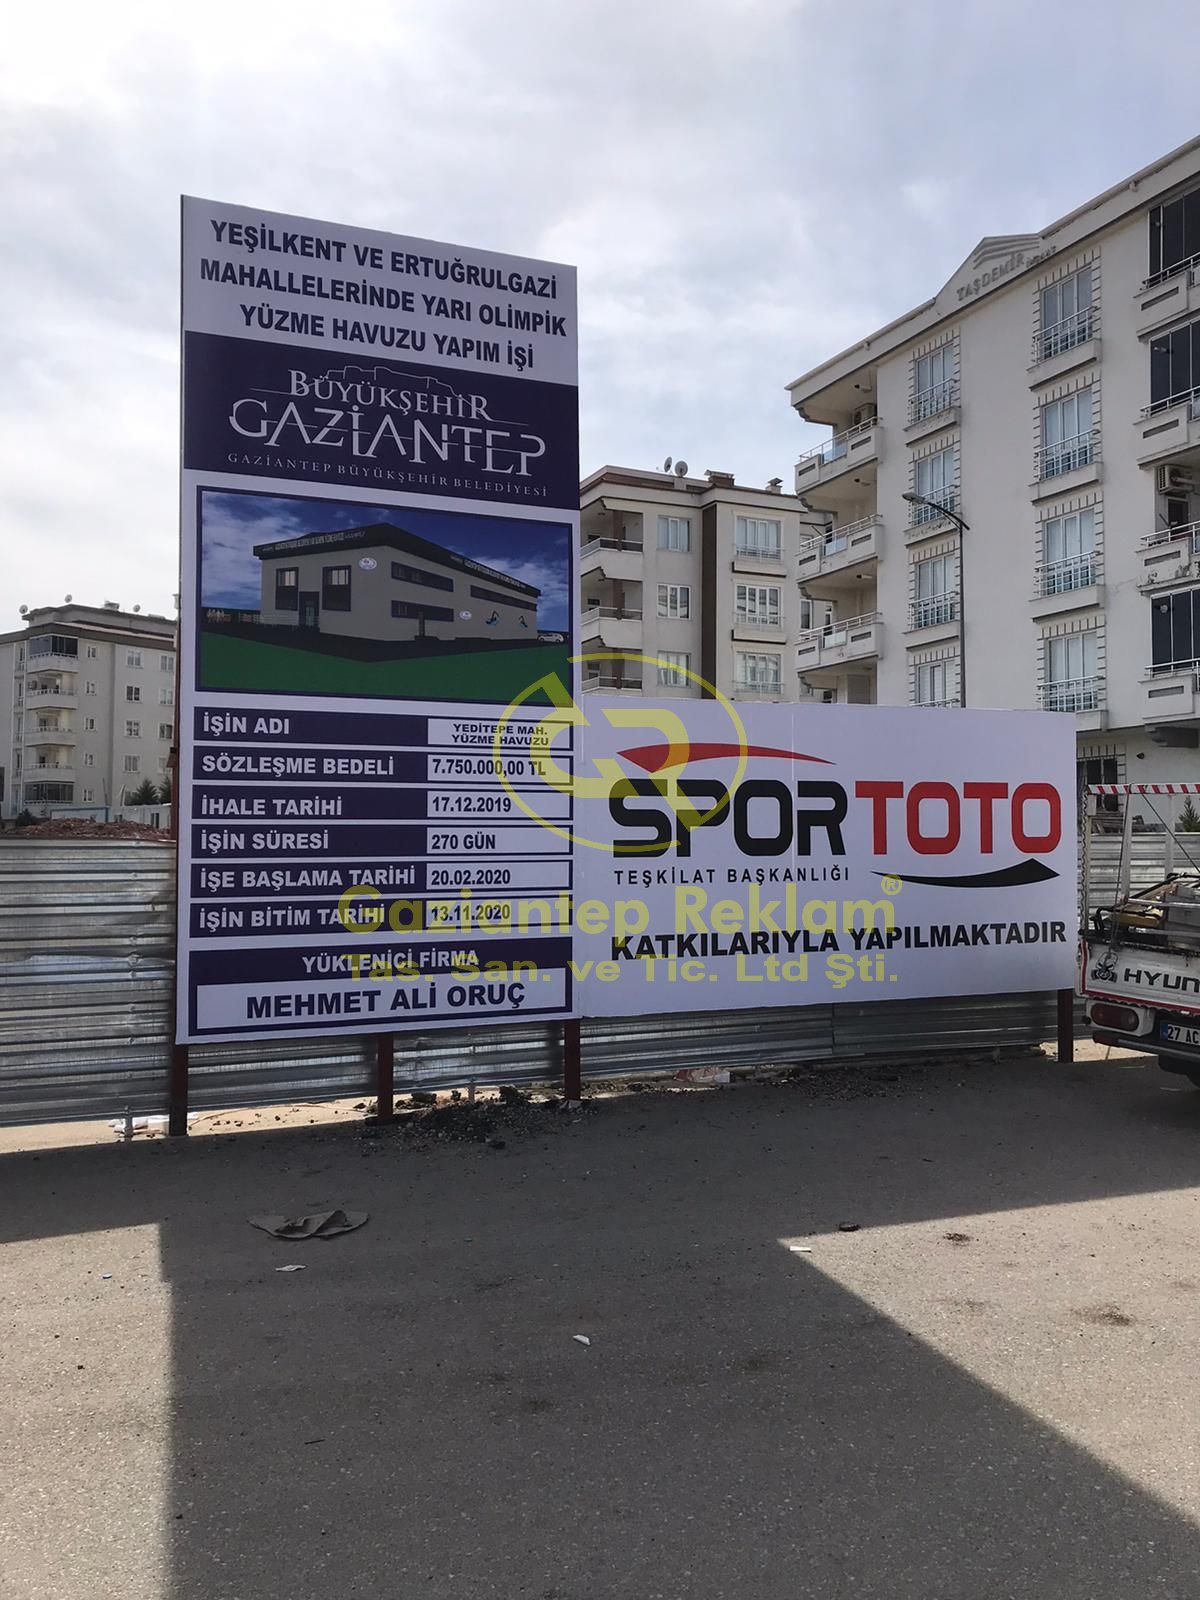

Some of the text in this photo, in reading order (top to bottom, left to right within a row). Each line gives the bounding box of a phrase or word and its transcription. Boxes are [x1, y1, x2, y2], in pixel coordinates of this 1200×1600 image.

[210, 219, 557, 299] YEŞİLKENT VE ERTUĞRULGAZİ
[200, 258, 567, 337] MAHALLELERİNDE YARI OLİMPİK
[239, 303, 534, 372] YÜZME HAVUZU YAPIM İŞİ
[288, 369, 493, 421] BÜYÜKŞEHİR
[229, 398, 546, 477] GAZİANTEP
[228, 452, 333, 474] GAZİANTEP
[337, 461, 448, 488] BÜYÜKŞEHİR
[203, 711, 290, 738] İŞİN ADI
[453, 721, 548, 736] YEDİTEPE MAH.
[451, 733, 549, 747] YÜZME HAVUZU
[202, 752, 394, 778] SÖZLEŞME BEDELİ
[432, 758, 546, 778] 7.750.000,00 TL
[201, 794, 343, 816] İHALE TARİHİ
[432, 796, 512, 813] 17.12.2019
[201, 828, 329, 855] İŞİN SÜRESİ
[431, 830, 496, 850] 270 GÜN
[200, 864, 415, 893] İŞE BAŞLAMA TARİHİ
[431, 869, 511, 886] 20.02.2020
[614, 864, 849, 889] TEŞKİLAT BAŞKANLIĞI
[200, 903, 385, 933] İŞİN BİTİM TARİHİ
[431, 904, 511, 922] 13.11.2020
[611, 920, 1067, 961] KATKILARIYLA YAPILMAKTADIR
[302, 946, 480, 973] YÜKLENİCİ FİRMA
[246, 982, 526, 1019] MEHMET ALİ ORUÇ
[1167, 1025, 1181, 1041] 27
